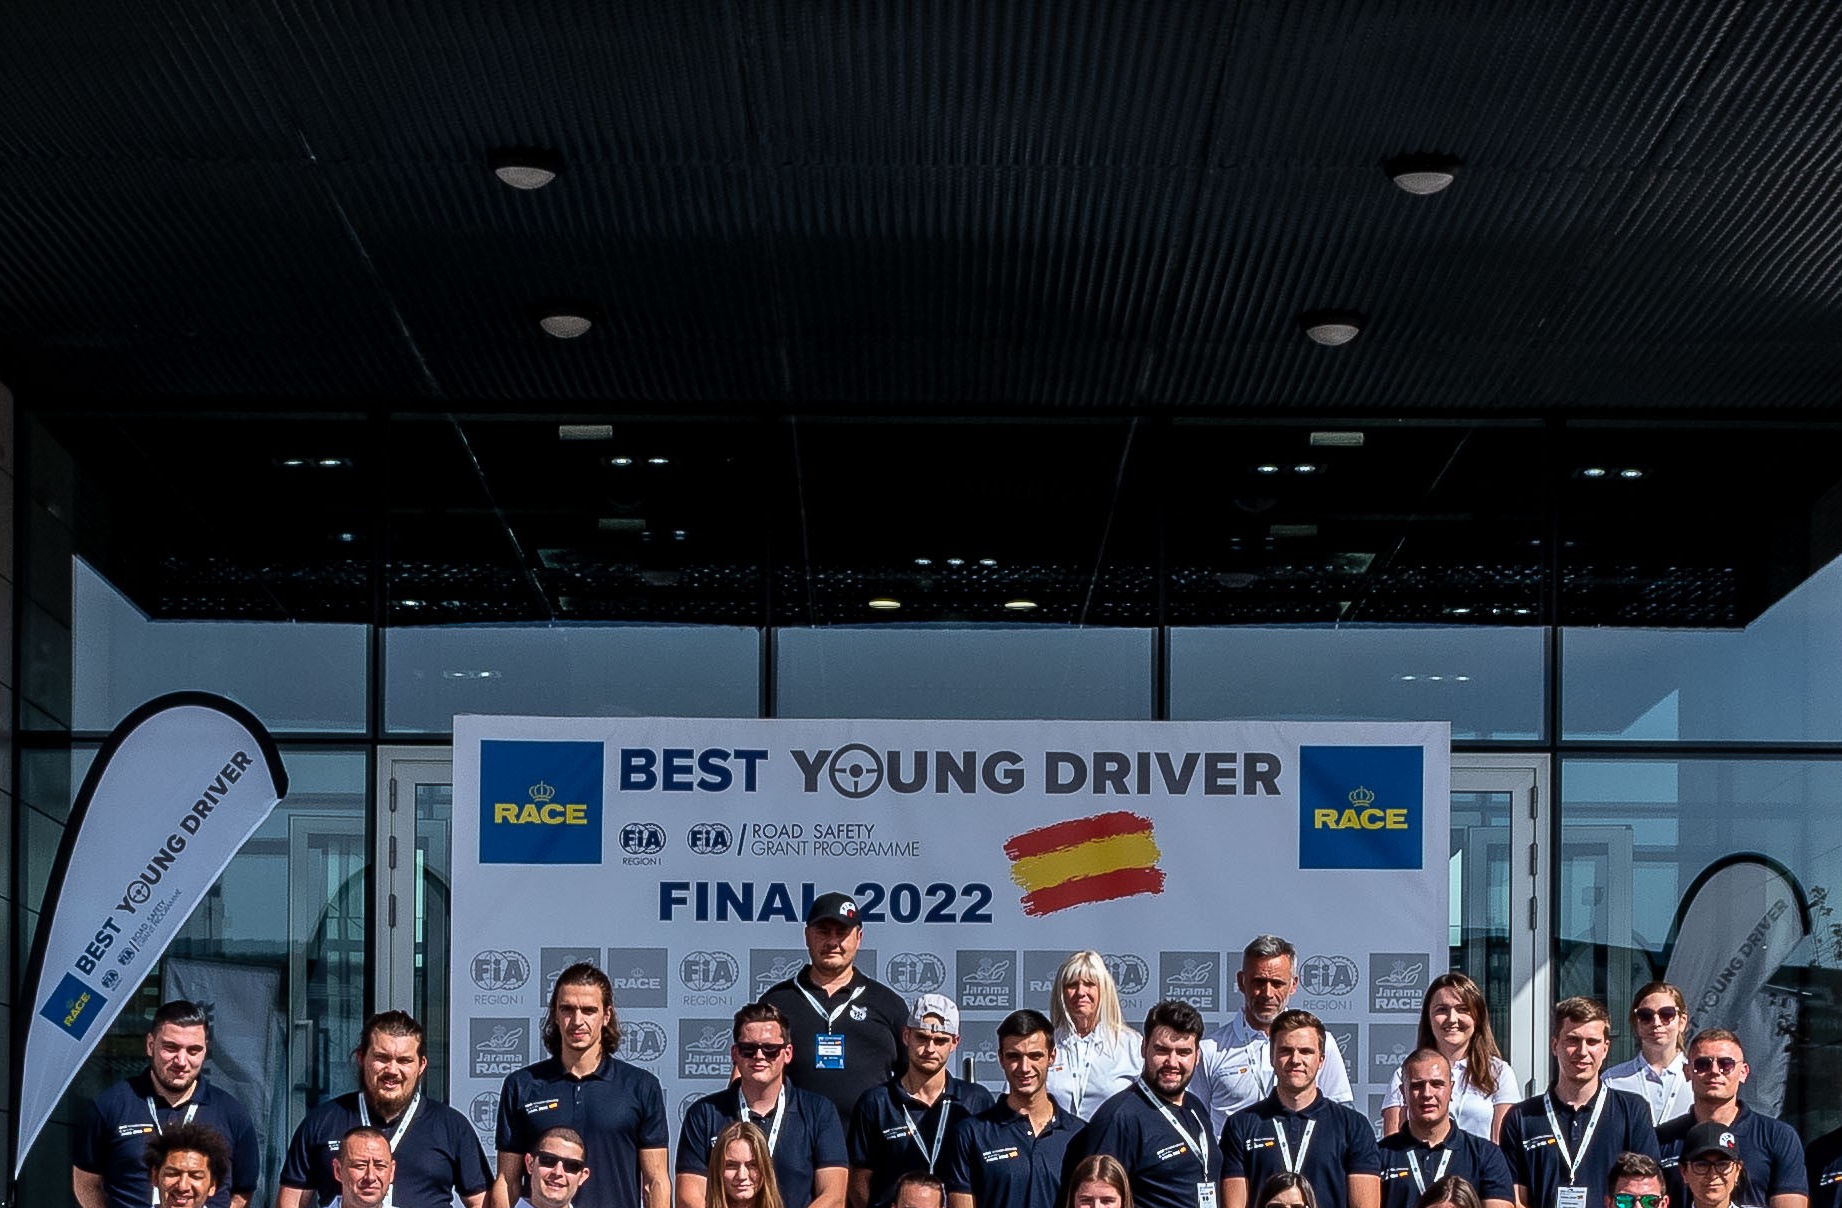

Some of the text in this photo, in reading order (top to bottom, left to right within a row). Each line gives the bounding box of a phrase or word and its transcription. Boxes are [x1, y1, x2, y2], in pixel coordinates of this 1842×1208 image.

[619, 743, 1282, 799] BEST YOUNG DRIVER
[494, 803, 588, 826] RACE
[1313, 808, 1409, 830] RACE
[752, 823, 876, 840] ROAD SAFETY
[751, 840, 921, 857] GRANT PROGRAMME
[75, 748, 254, 976] BEST YOUNG DRIVER
[622, 857, 657, 866] REGION
[853, 882, 994, 924] 2022
[1738, 898, 1790, 959] DRIVER
[612, 978, 661, 989] RACE
[962, 984, 1009, 994] Jarama
[1029, 981, 1053, 992] RA
[1165, 986, 1213, 996] Jarama
[1375, 987, 1423, 998] Jarama
[474, 995, 519, 1005] REGION
[683, 996, 727, 1006] REGION
[962, 995, 1009, 1007] RACE
[1302, 1001, 1347, 1010] REGION
[1375, 998, 1422, 1009] RACE
[63, 991, 91, 1027] RACE
[476, 1052, 523, 1063] Jarama
[685, 1053, 731, 1063] Jarama
[962, 1051, 999, 1062] RAC
[476, 1063, 522, 1074] RACE
[685, 1064, 732, 1075] RACE
